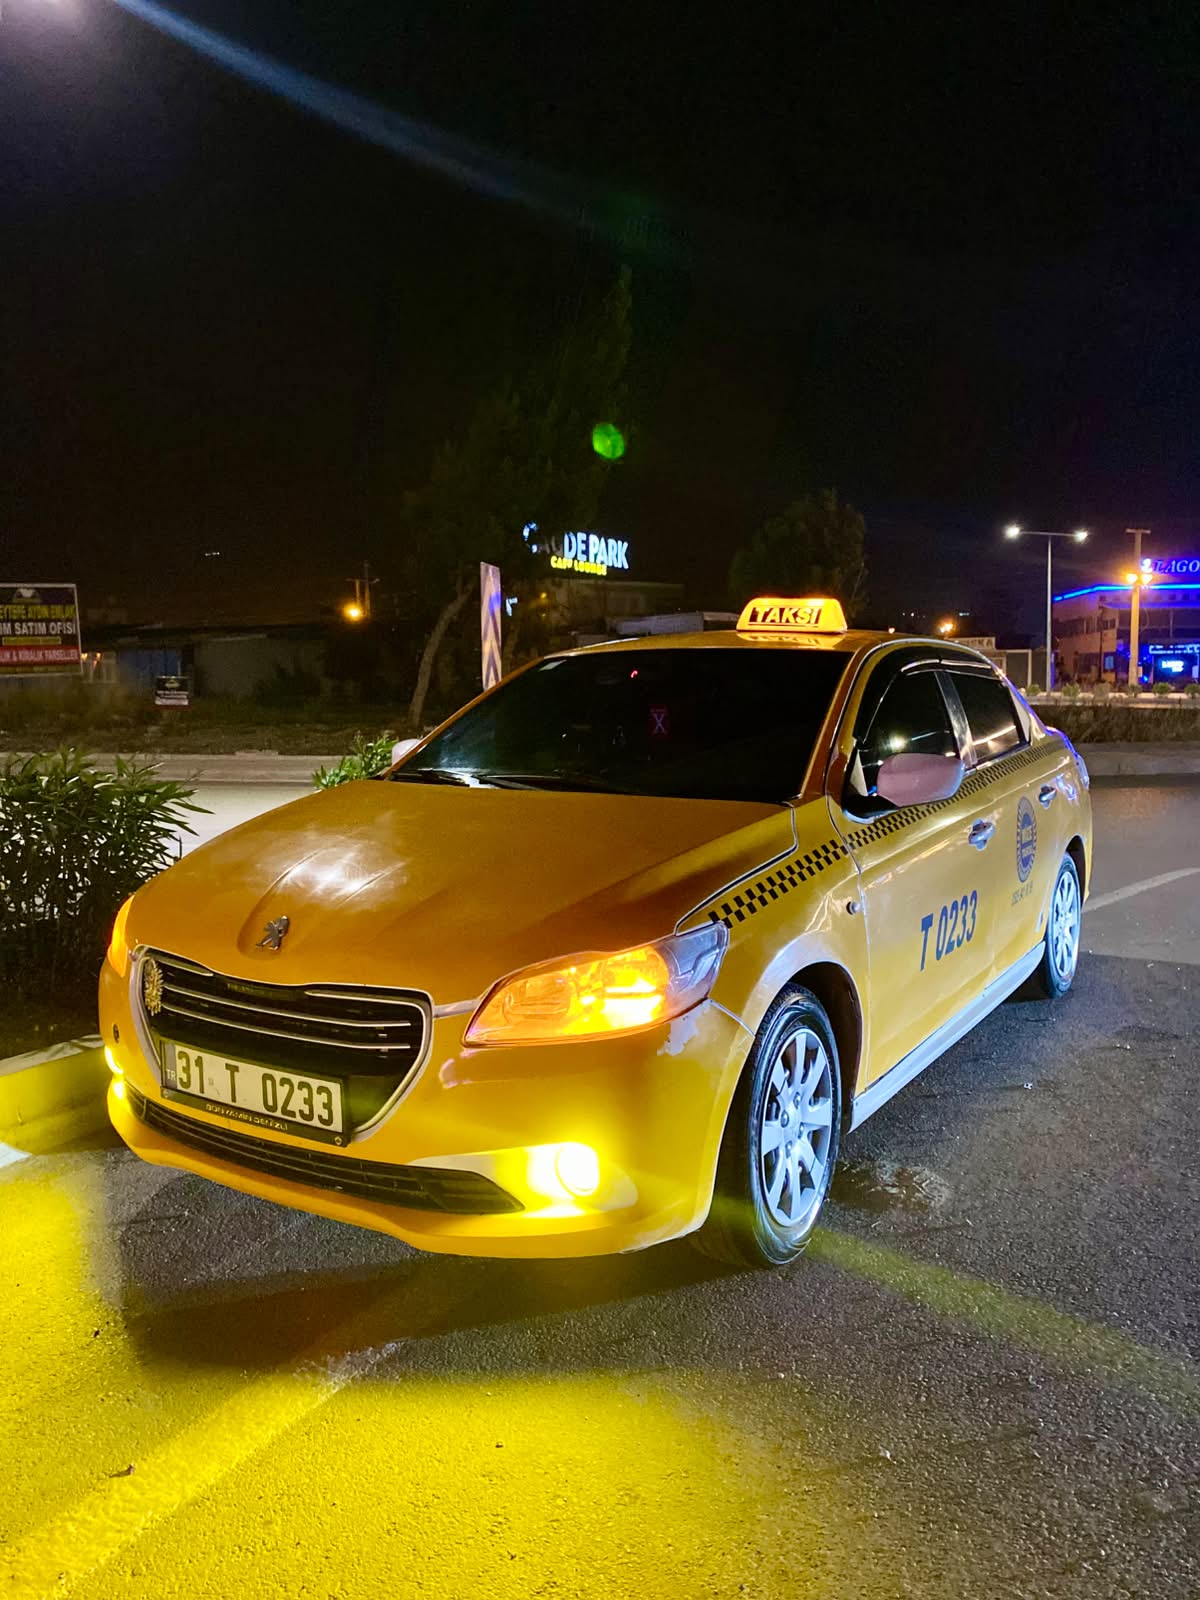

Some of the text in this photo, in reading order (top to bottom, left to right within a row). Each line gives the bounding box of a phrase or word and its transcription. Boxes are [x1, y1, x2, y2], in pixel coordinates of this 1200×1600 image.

[588, 533, 629, 569] PARK
[15, 622, 47, 635] SATIM
[920, 912, 934, 972] T
[936, 889, 978, 961] 0233
[166, 1068, 177, 1082] TR
[177, 1050, 334, 1127] 31 T 0233
